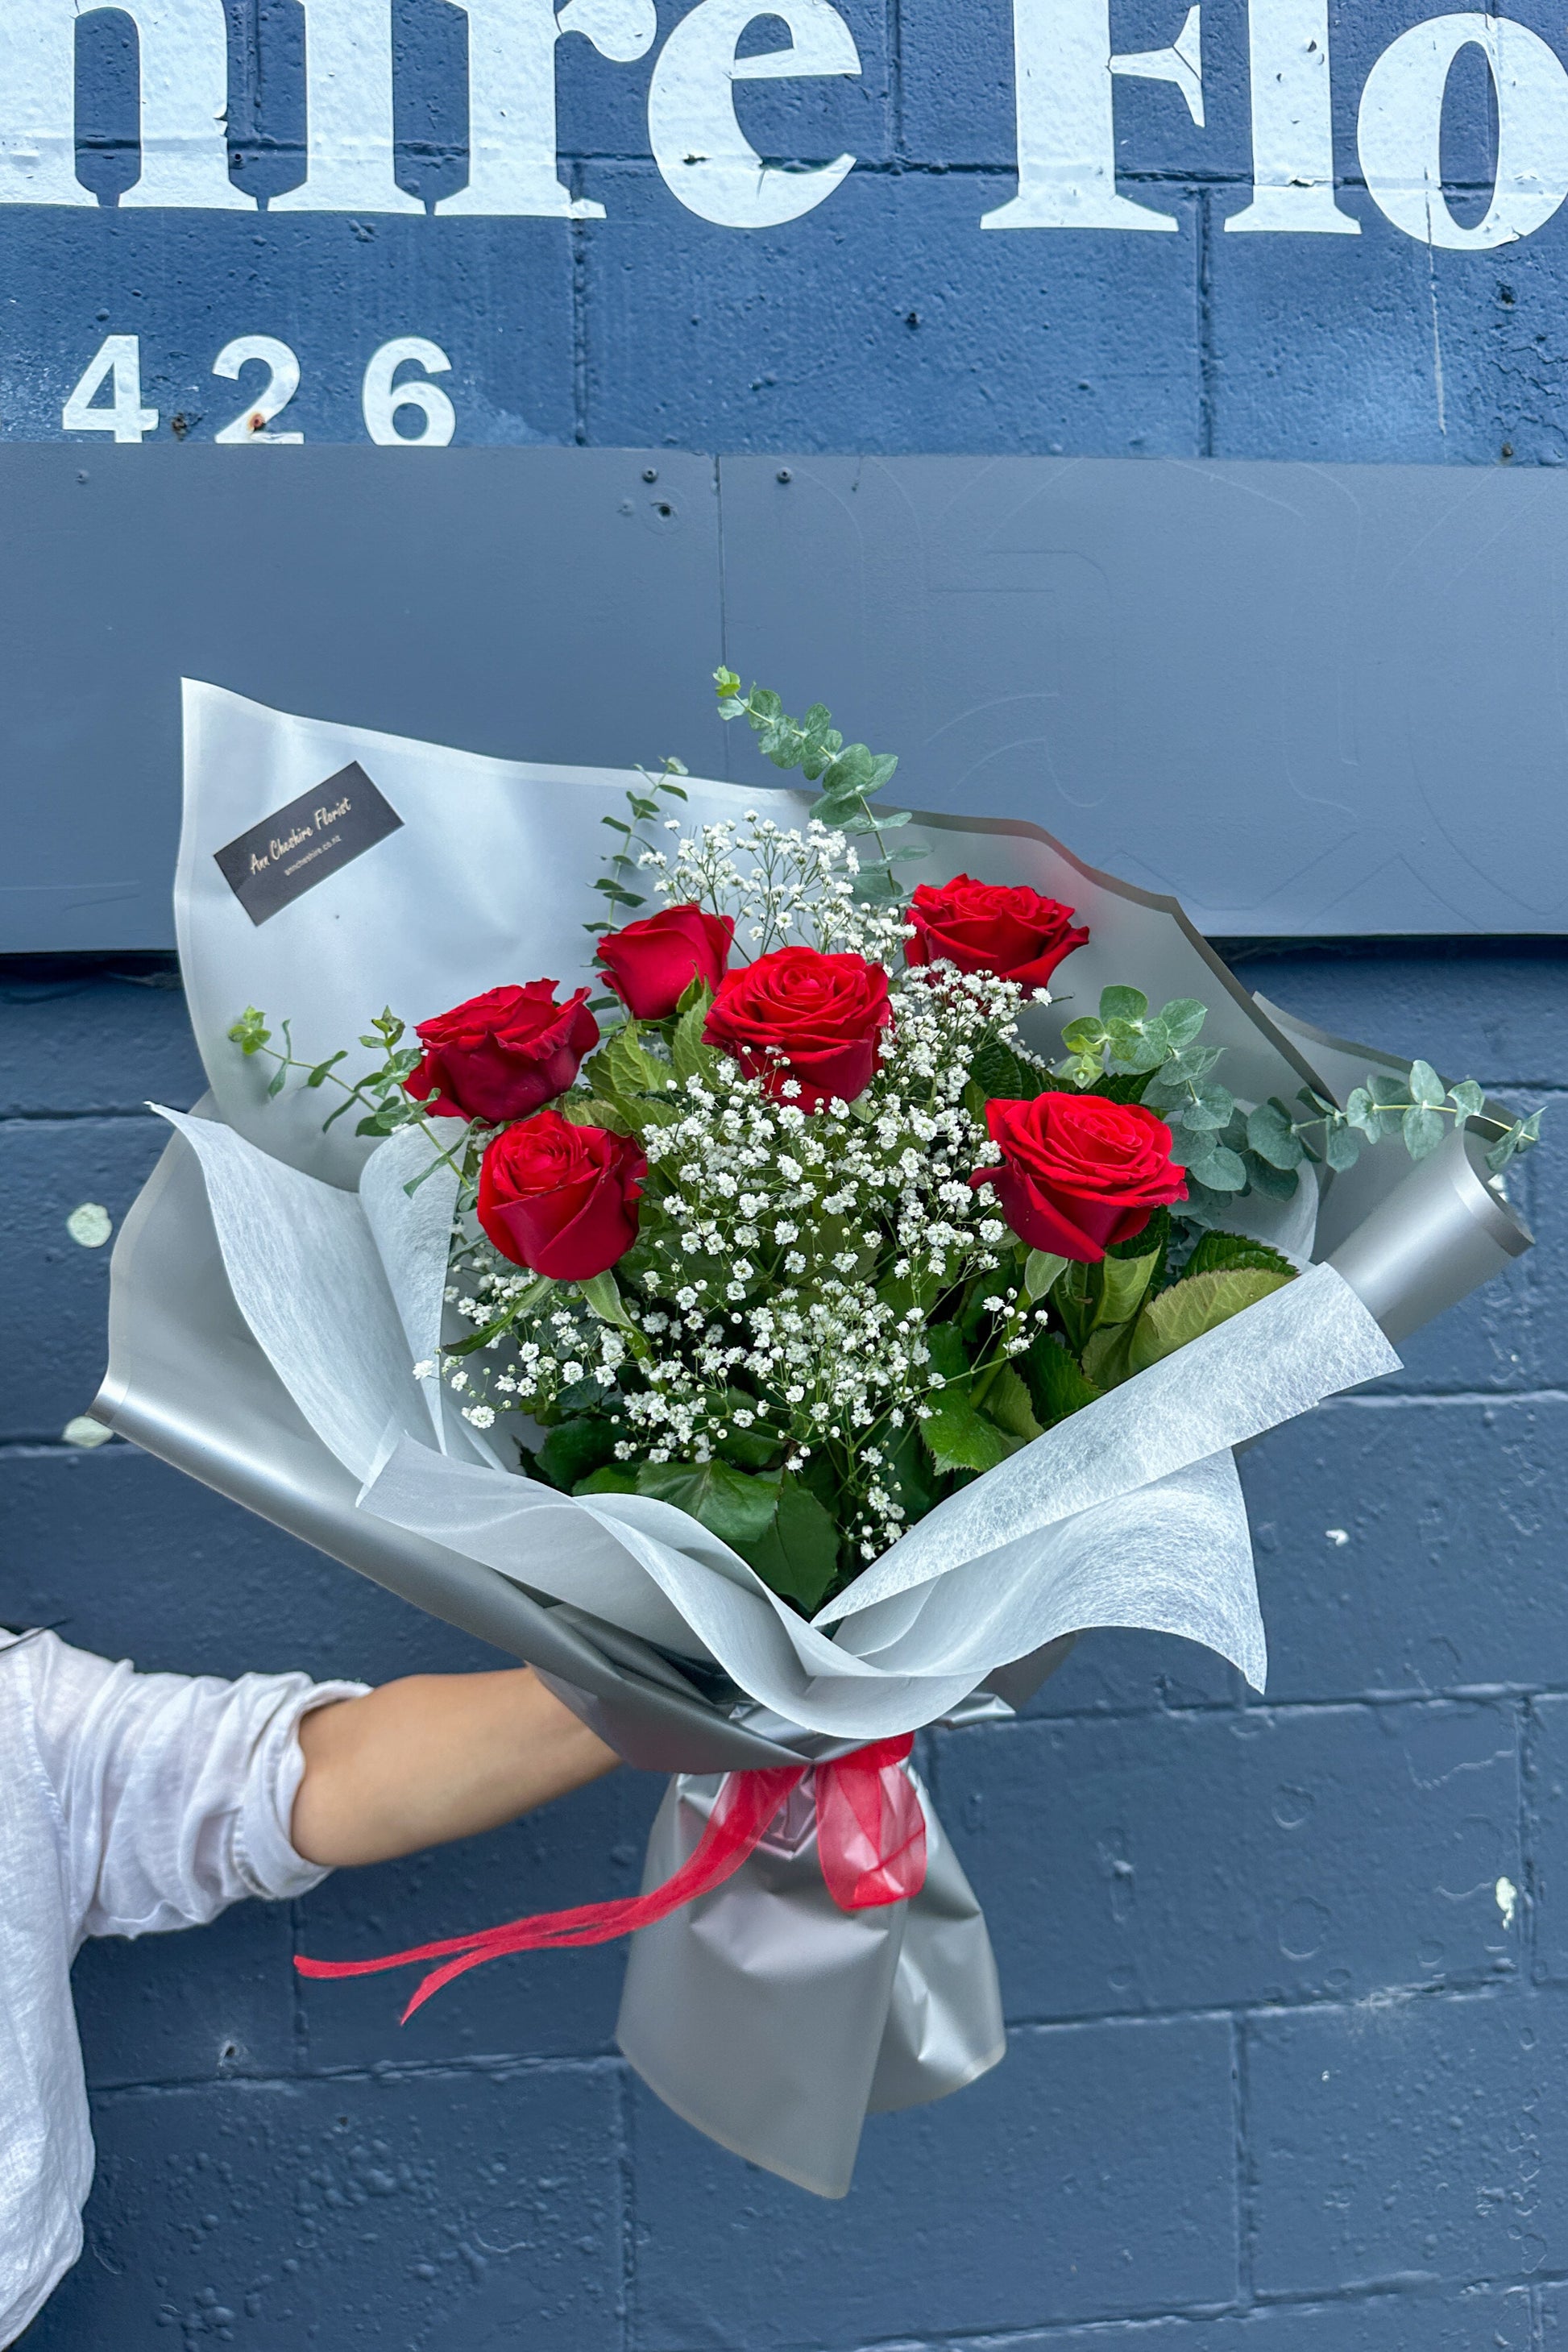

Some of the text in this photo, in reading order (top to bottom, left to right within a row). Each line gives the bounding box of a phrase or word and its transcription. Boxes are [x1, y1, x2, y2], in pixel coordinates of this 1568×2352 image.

[980, 0, 1568, 251] Flo
[251, 797, 352, 875] Ann Cheshire Florist
